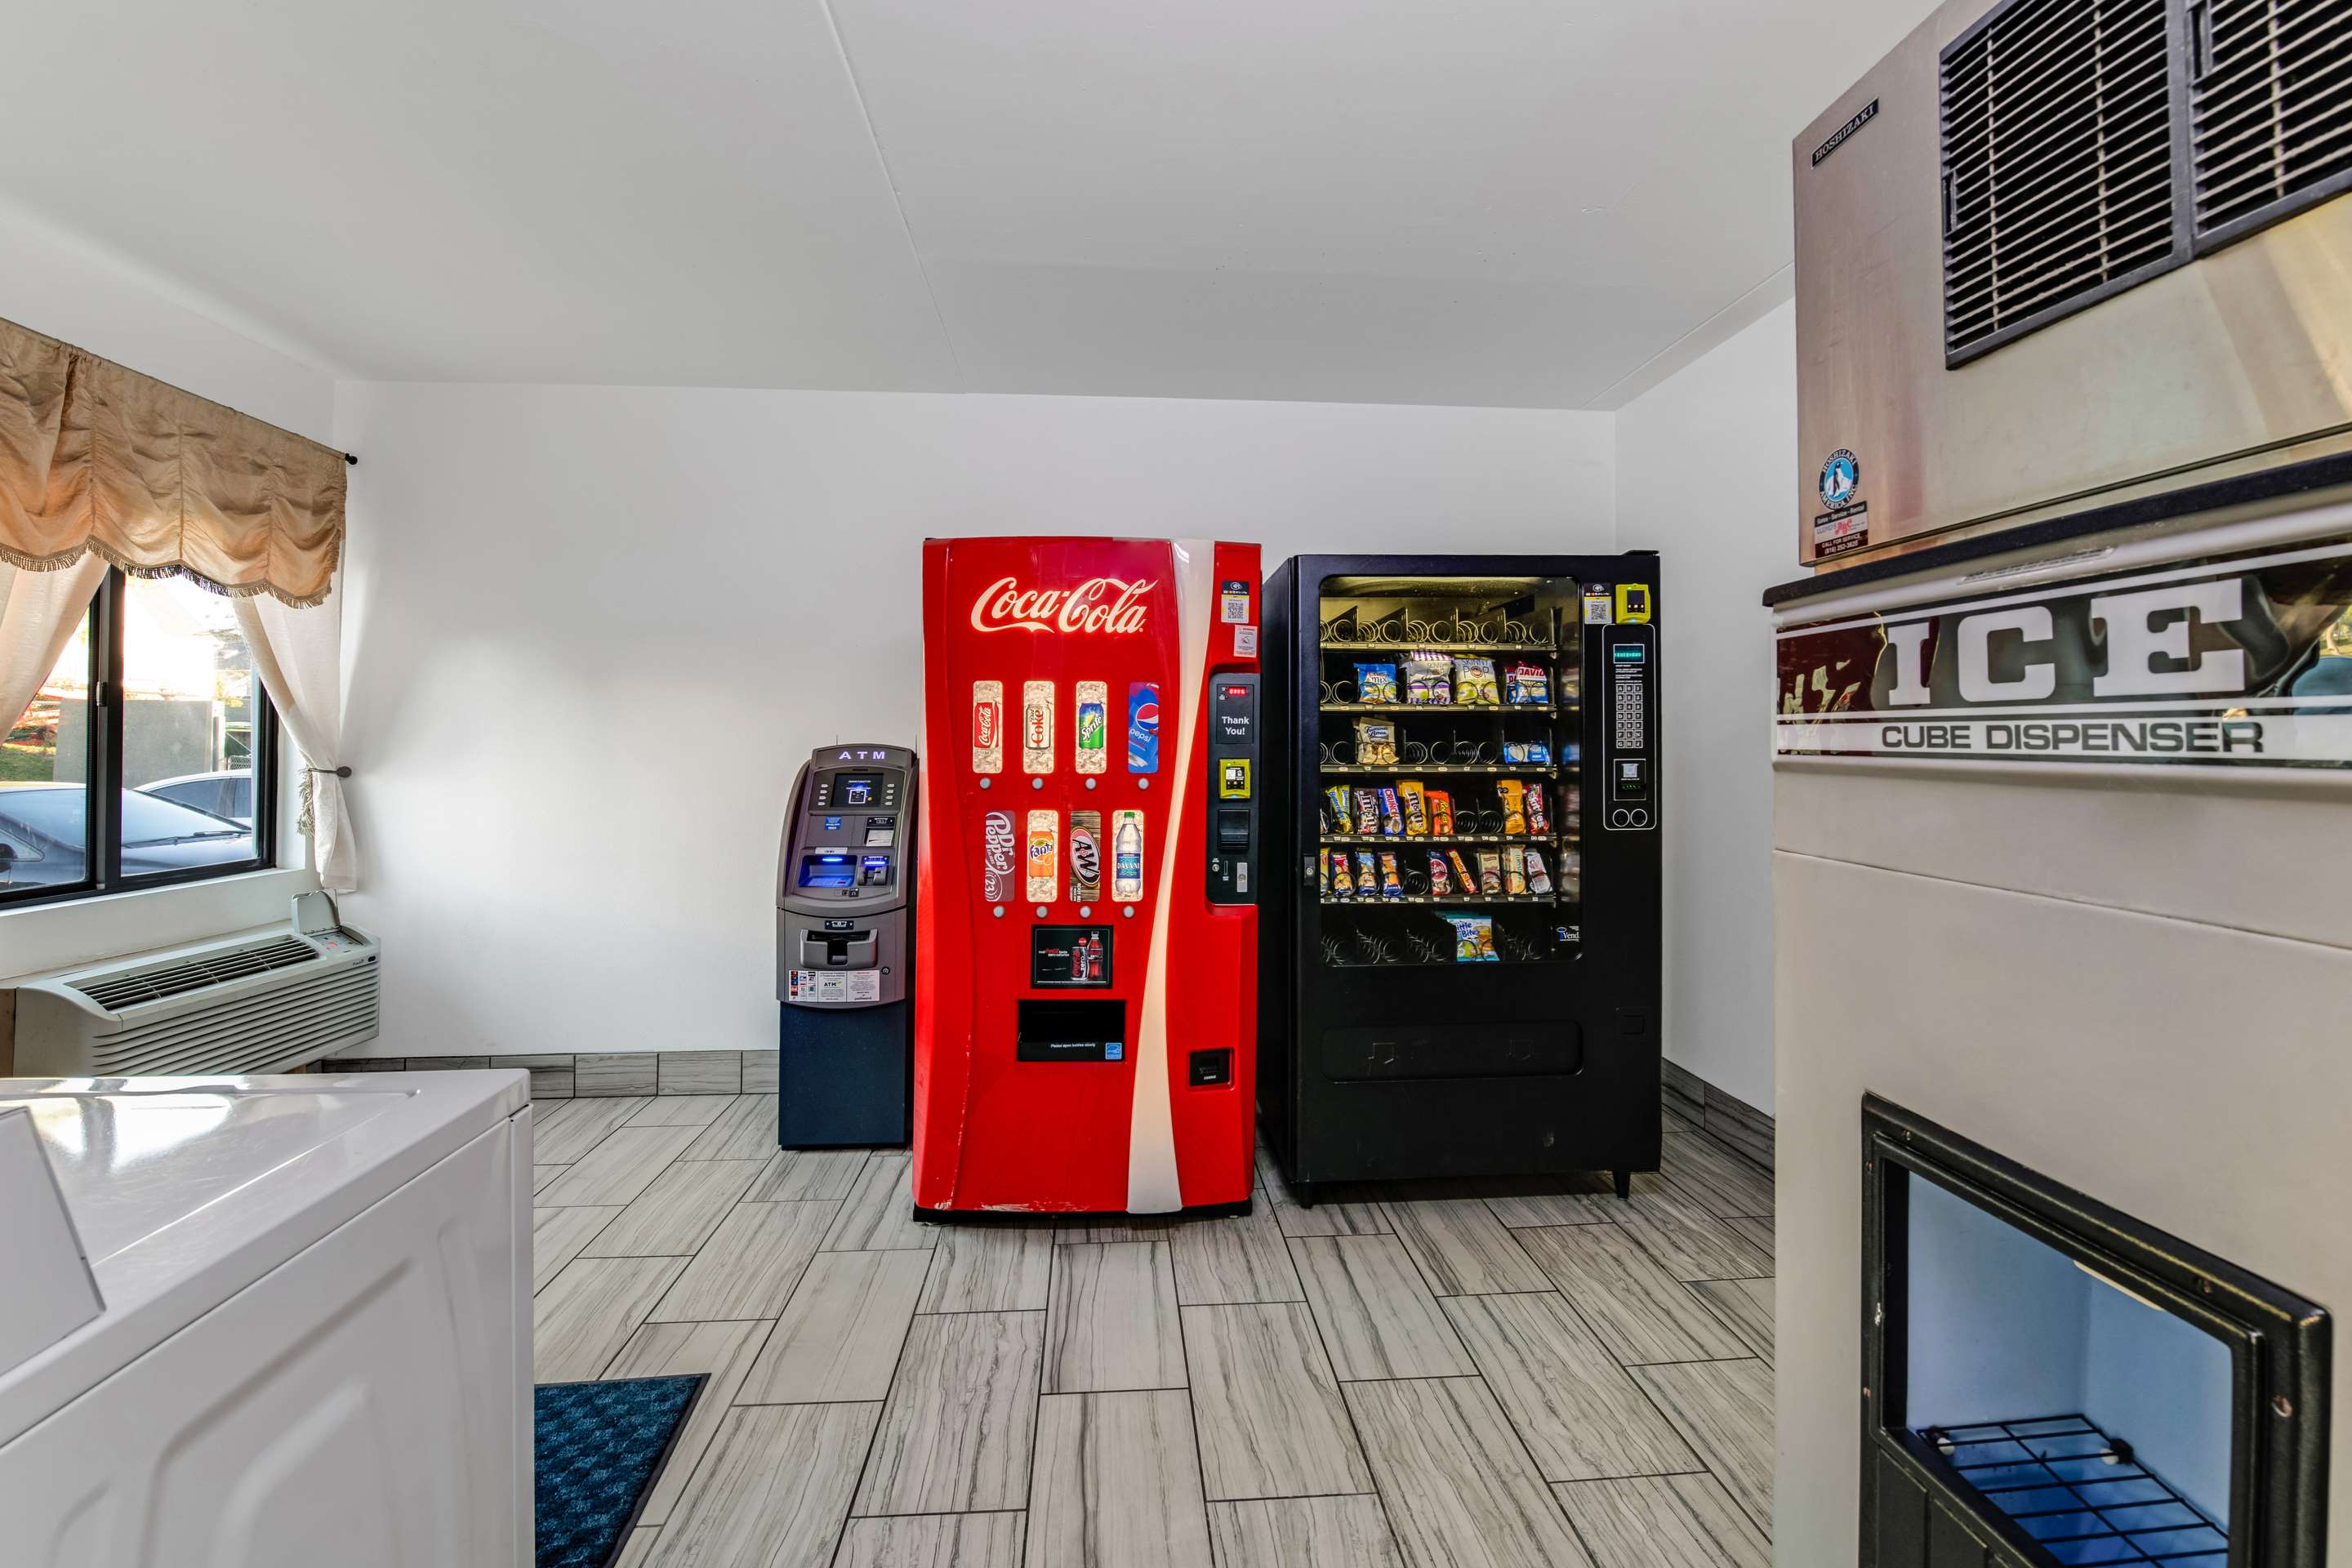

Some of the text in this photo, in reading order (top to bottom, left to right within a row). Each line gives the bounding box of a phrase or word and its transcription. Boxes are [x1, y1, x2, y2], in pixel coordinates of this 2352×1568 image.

[1815, 104, 1874, 163] HOSHIZAKI
[1822, 448, 1857, 473] HOSHIZAKI
[970, 576, 1159, 634] Coca-Cola
[1887, 578, 2245, 706] ICE
[1463, 666, 1490, 679] POP
[1519, 667, 1545, 677] DAVID
[978, 706, 991, 746] Coca-Cola
[1031, 709, 1045, 744] Coke
[1080, 713, 1102, 742] Sprite
[1222, 715, 1250, 725] Thank
[1225, 726, 1245, 736] You!
[1129, 728, 1152, 744] pepsi
[1882, 721, 2265, 754] CUBE DISPENSER
[838, 751, 886, 760] ATM
[1385, 789, 1400, 818] CRUNCH
[985, 812, 1011, 871] Pepper
[997, 833, 1015, 856] Dr
[1072, 838, 1101, 875] A&W
[985, 878, 996, 893] 23
[1456, 922, 1472, 931] ittle
[1462, 929, 1481, 938] Bites
